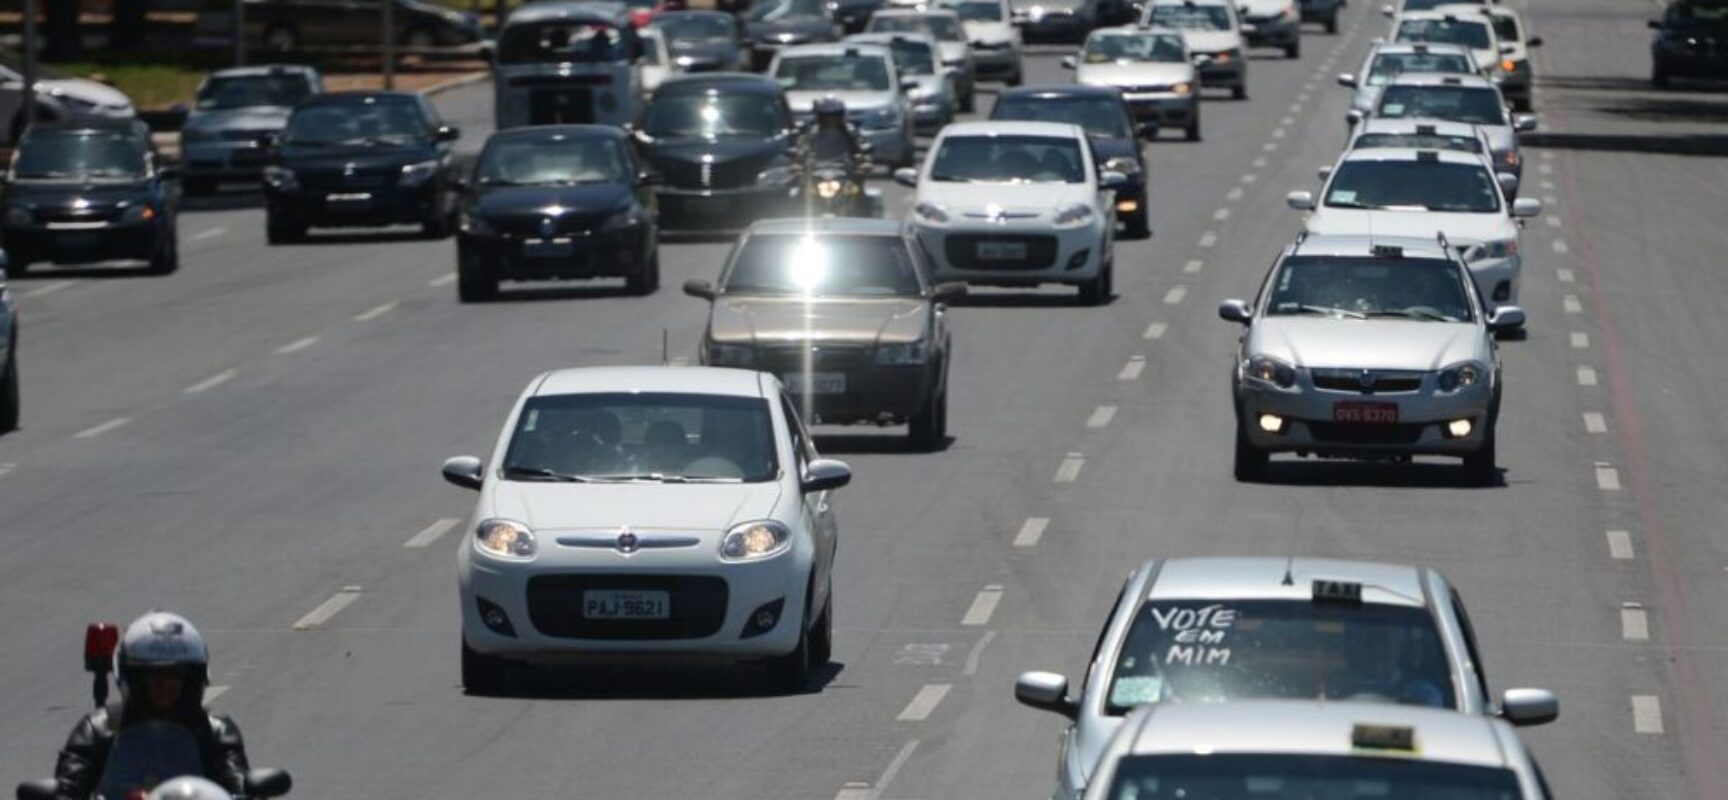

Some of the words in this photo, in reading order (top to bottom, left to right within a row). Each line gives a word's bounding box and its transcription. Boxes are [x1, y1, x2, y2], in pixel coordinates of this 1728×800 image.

[1313, 581, 1359, 598] TAXI
[1151, 604, 1236, 630] VOTE
[1174, 628, 1225, 644] EM
[1165, 645, 1231, 666] MIM
